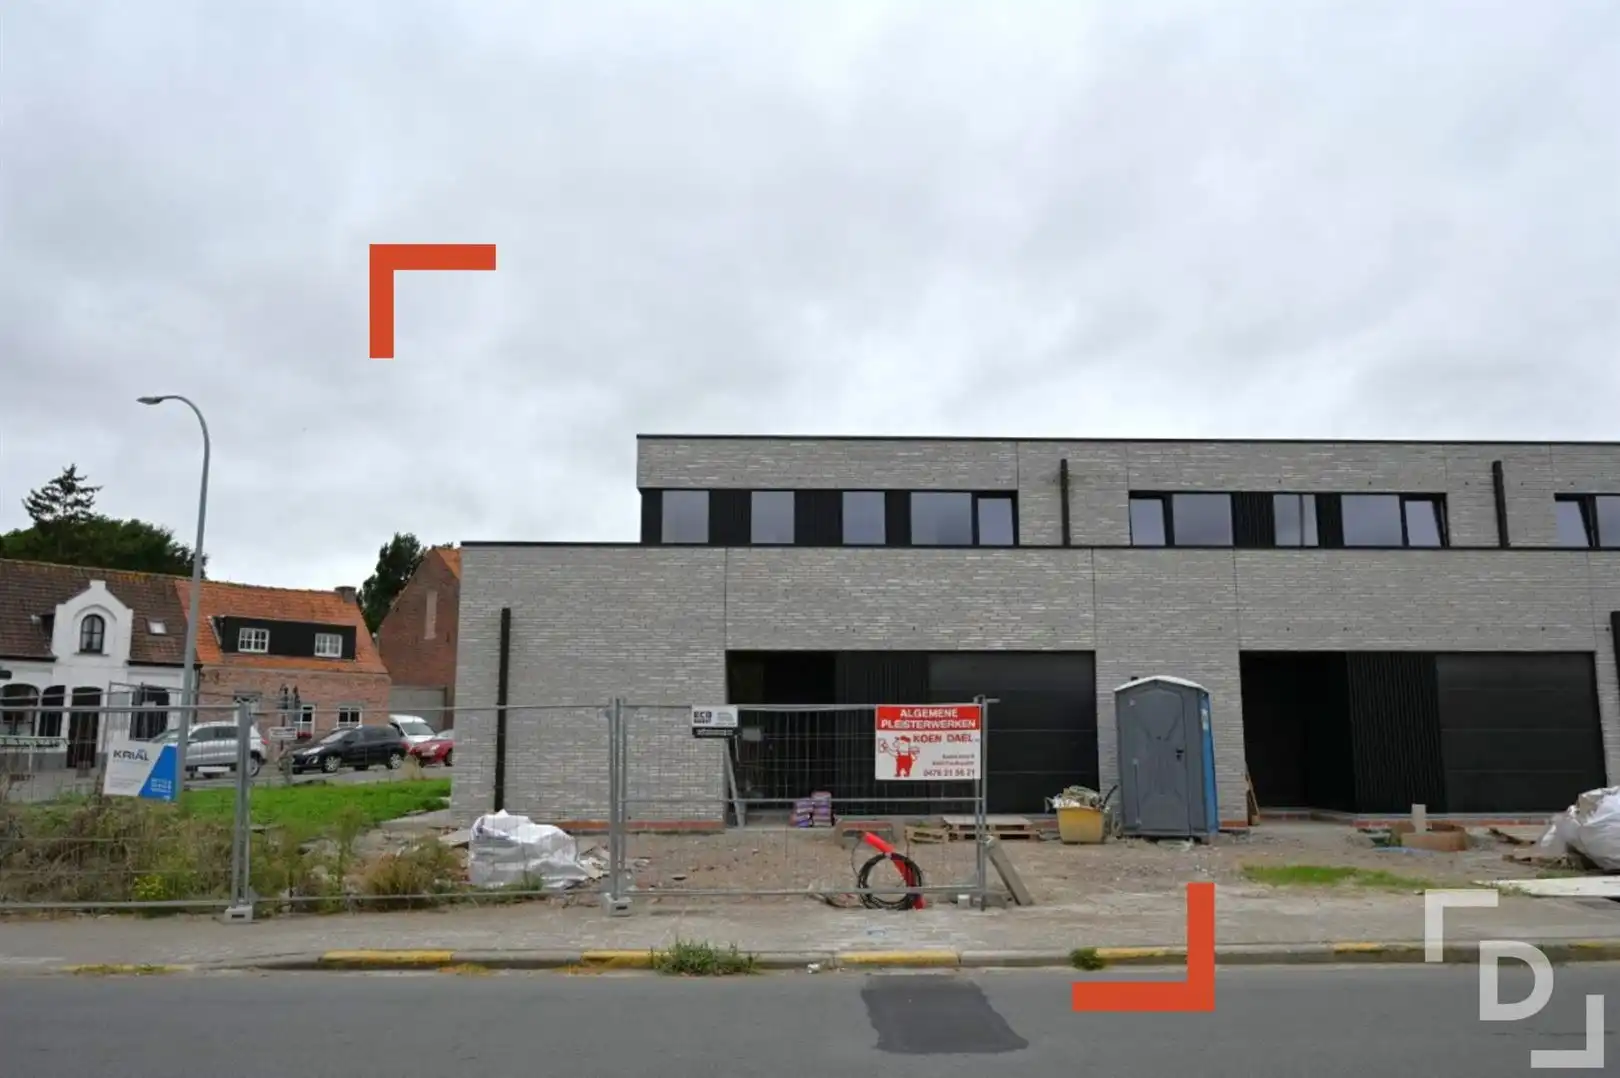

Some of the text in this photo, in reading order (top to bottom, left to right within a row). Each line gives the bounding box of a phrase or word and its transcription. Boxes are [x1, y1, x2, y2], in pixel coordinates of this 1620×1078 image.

[900, 708, 958, 718] ALGEMENE
[881, 719, 976, 729] PLEISTERWERKEN
[913, 734, 942, 743] KOEN
[946, 734, 973, 743] DAEL
[112, 749, 150, 761] KRIAL
